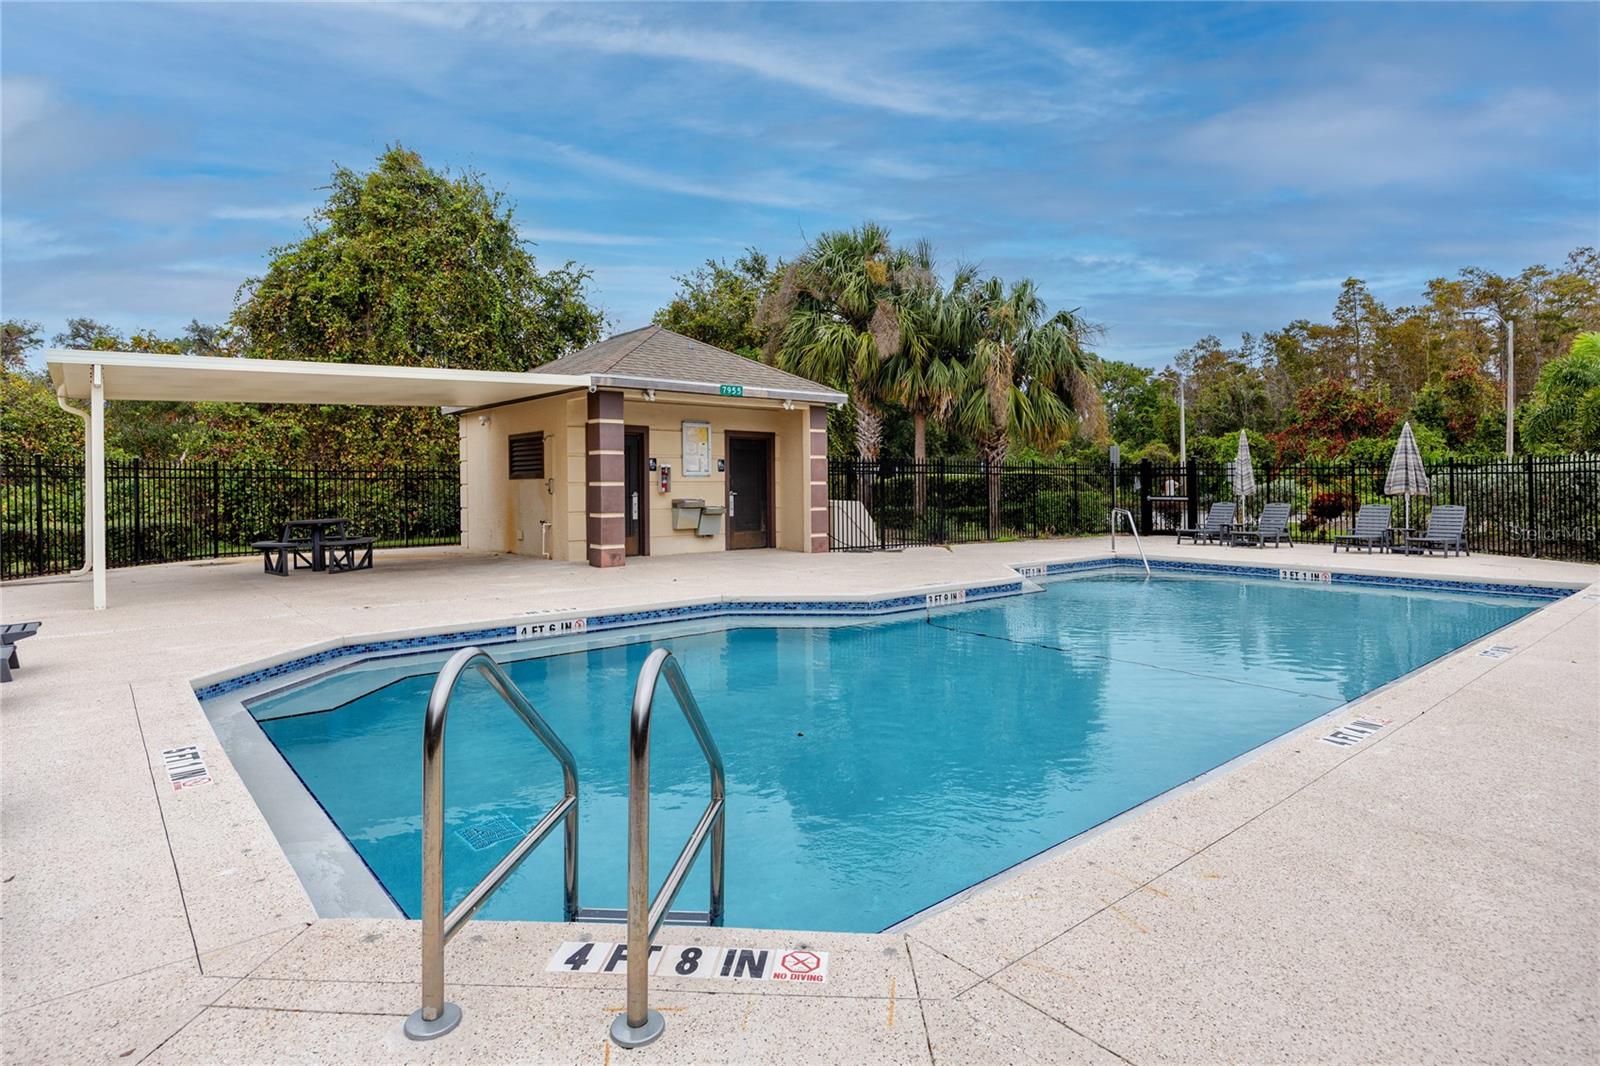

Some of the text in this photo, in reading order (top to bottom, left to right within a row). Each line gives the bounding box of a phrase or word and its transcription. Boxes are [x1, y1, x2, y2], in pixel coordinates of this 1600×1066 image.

[721, 386, 742, 395] 7955
[950, 592, 957, 600] IN
[532, 625, 545, 634] FT
[560, 621, 572, 631] IN
[1329, 730, 1364, 743] FT
[165, 751, 201, 764] FT
[563, 942, 595, 971] 4
[674, 946, 703, 976] 8
[719, 948, 769, 979] IN
[790, 973, 823, 982] DIVING
